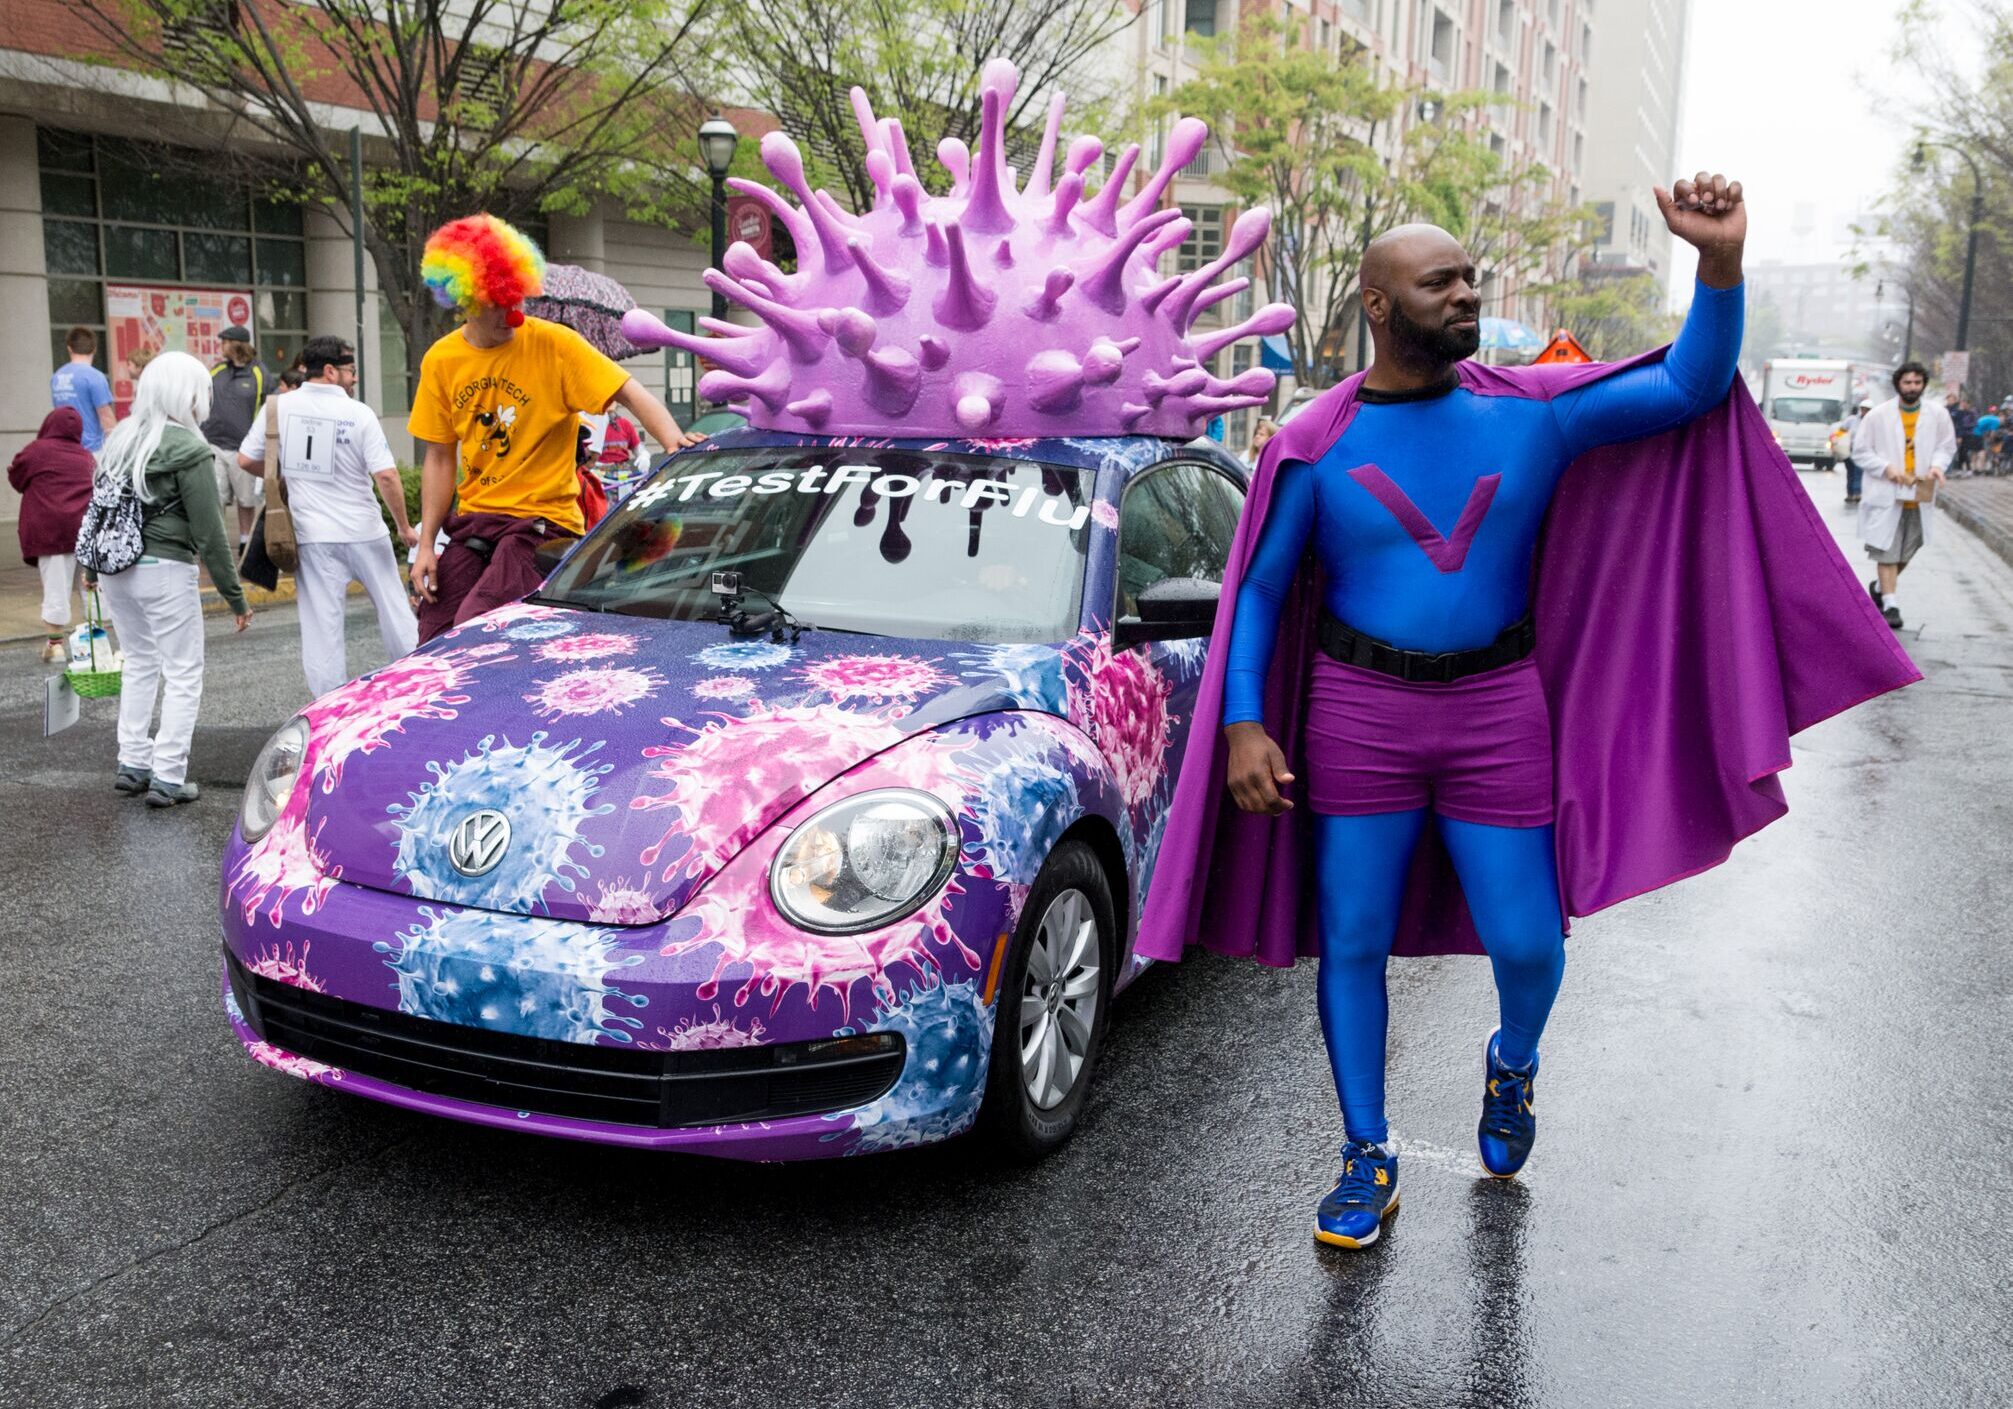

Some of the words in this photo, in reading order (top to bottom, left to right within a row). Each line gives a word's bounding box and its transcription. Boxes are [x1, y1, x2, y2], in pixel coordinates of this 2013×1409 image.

[500, 378, 531, 407] TECH
[1796, 375, 1834, 386] Ryder
[627, 465, 1090, 530] #TestForFlu
[1346, 463, 1503, 575] V
